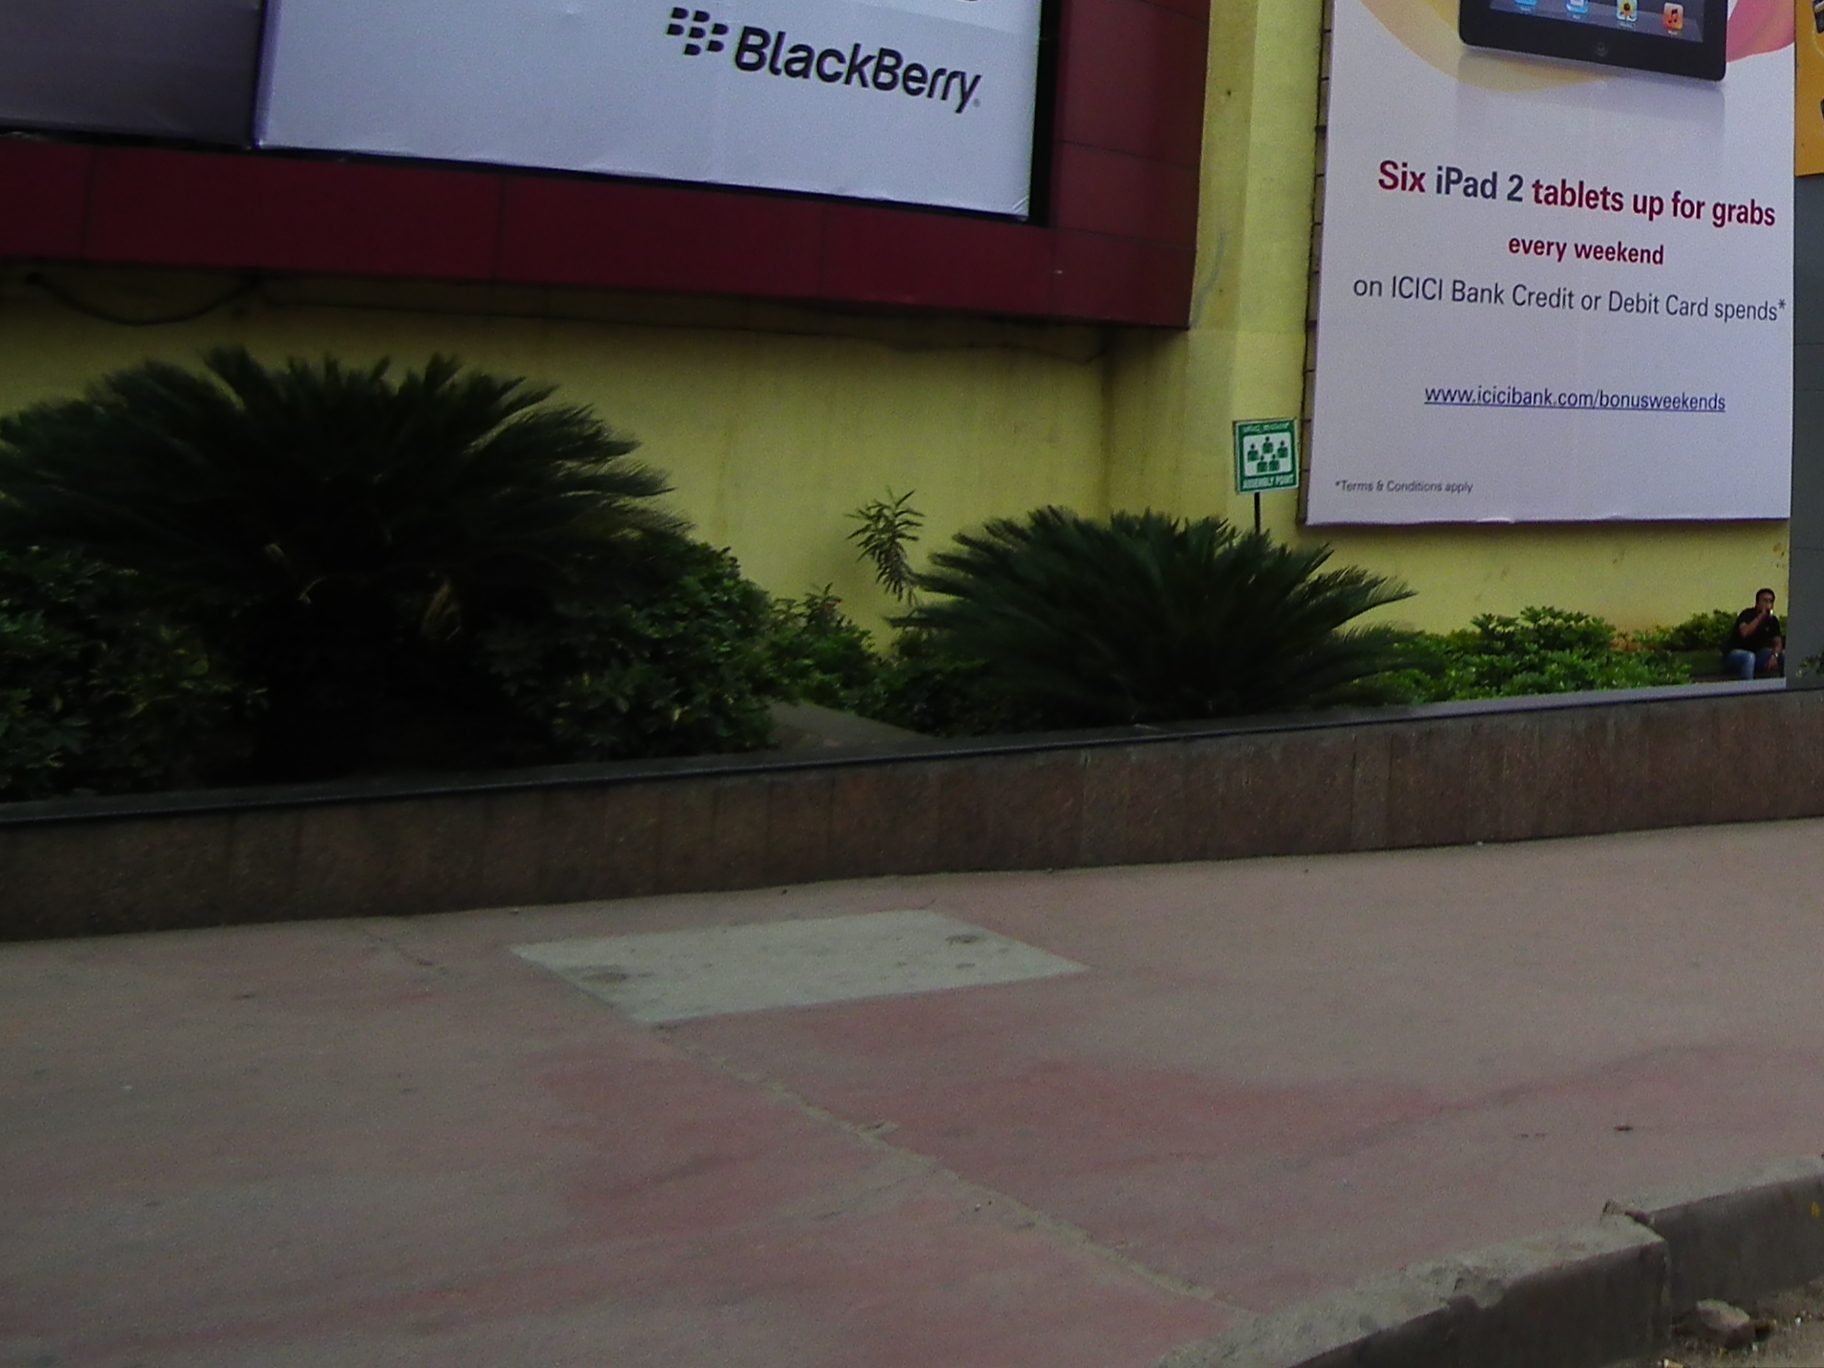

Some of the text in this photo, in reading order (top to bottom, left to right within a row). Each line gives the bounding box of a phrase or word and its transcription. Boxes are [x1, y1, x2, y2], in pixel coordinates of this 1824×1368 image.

[734, 25, 982, 114] BlackBerry
[1378, 160, 1776, 229] Six iPad 2 tablets up for grabs
[1507, 236, 1664, 265] every weekend
[1353, 277, 1382, 298] on
[1391, 275, 1443, 300] ICICI
[1452, 279, 1504, 305] Bank
[1512, 284, 1574, 311] Credit
[1580, 292, 1601, 312] or
[1608, 289, 1660, 316] Debit
[1665, 294, 1708, 318] Card
[1424, 385, 1726, 412] www.icicibank.com/bonusweekends
[1386, 480, 1443, 493] Conditions
[1445, 481, 1474, 494] apply
